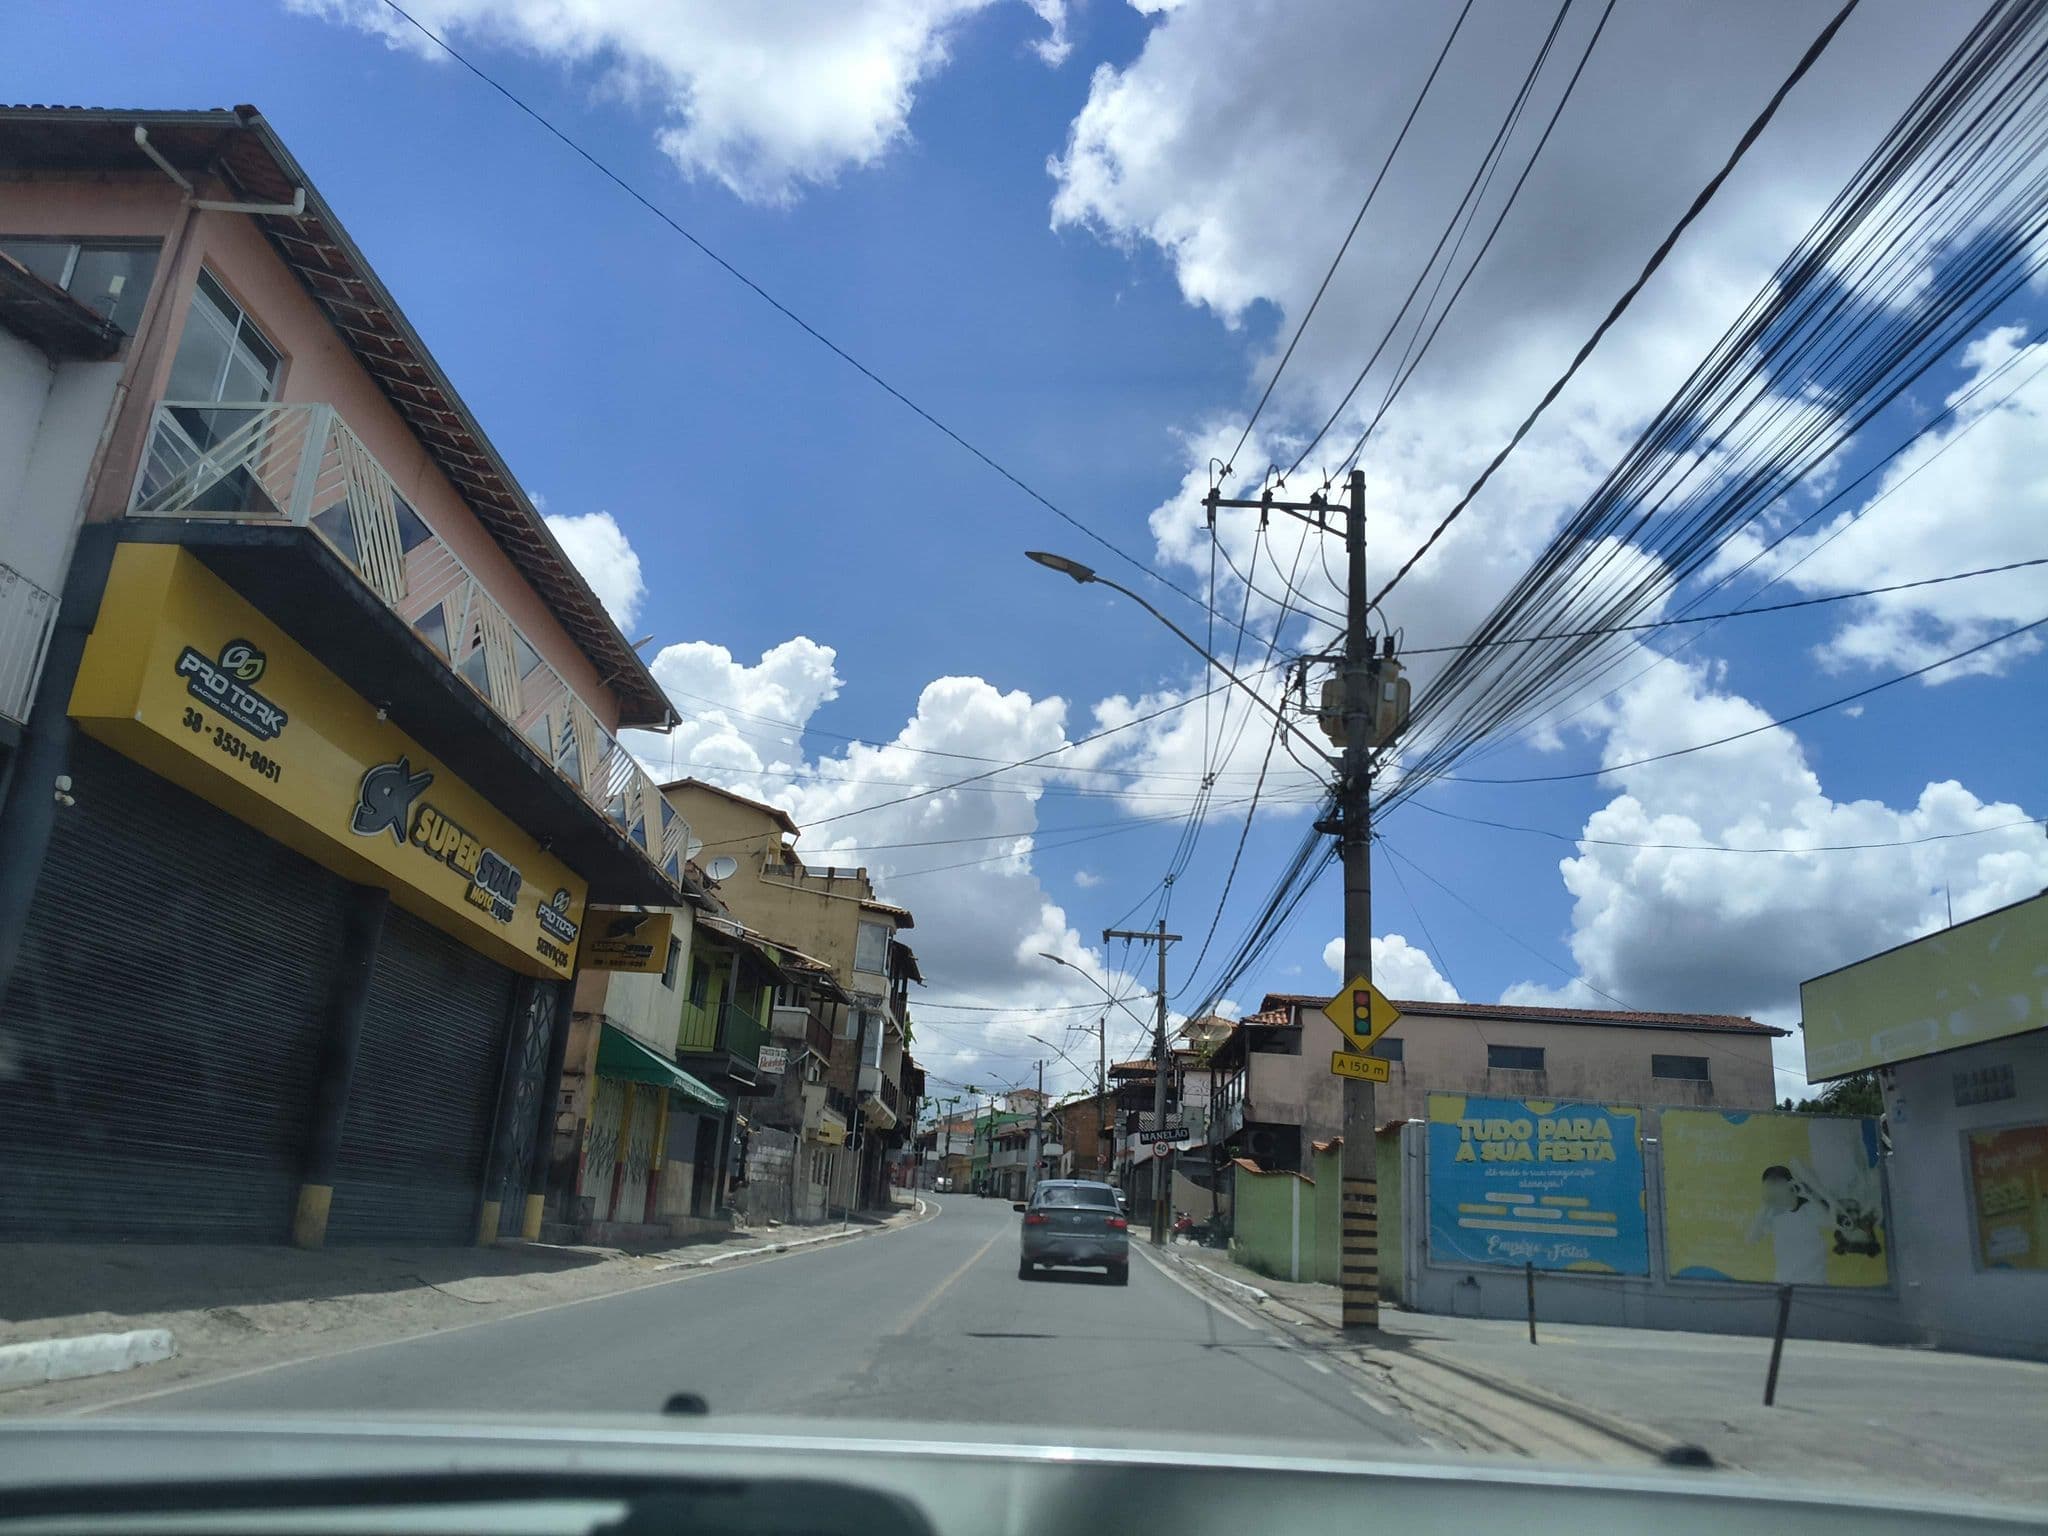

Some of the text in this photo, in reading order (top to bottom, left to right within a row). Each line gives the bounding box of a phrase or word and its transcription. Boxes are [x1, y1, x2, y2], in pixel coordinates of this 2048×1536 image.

[180, 653, 285, 732] PRO TORK
[192, 684, 220, 705] RACING
[182, 706, 203, 733] 38
[213, 727, 282, 783] 3531-8051
[415, 808, 522, 906] SUPER STAR
[470, 886, 494, 910] MOTO
[537, 904, 557, 925] PRO
[556, 915, 578, 938] TORK
[1336, 1059, 1384, 1076] A 150 m
[1456, 1117, 1613, 1142] TUDO PARA
[1156, 1143, 1167, 1153] 40
[1455, 1142, 1617, 1162] A SUA FESTA
